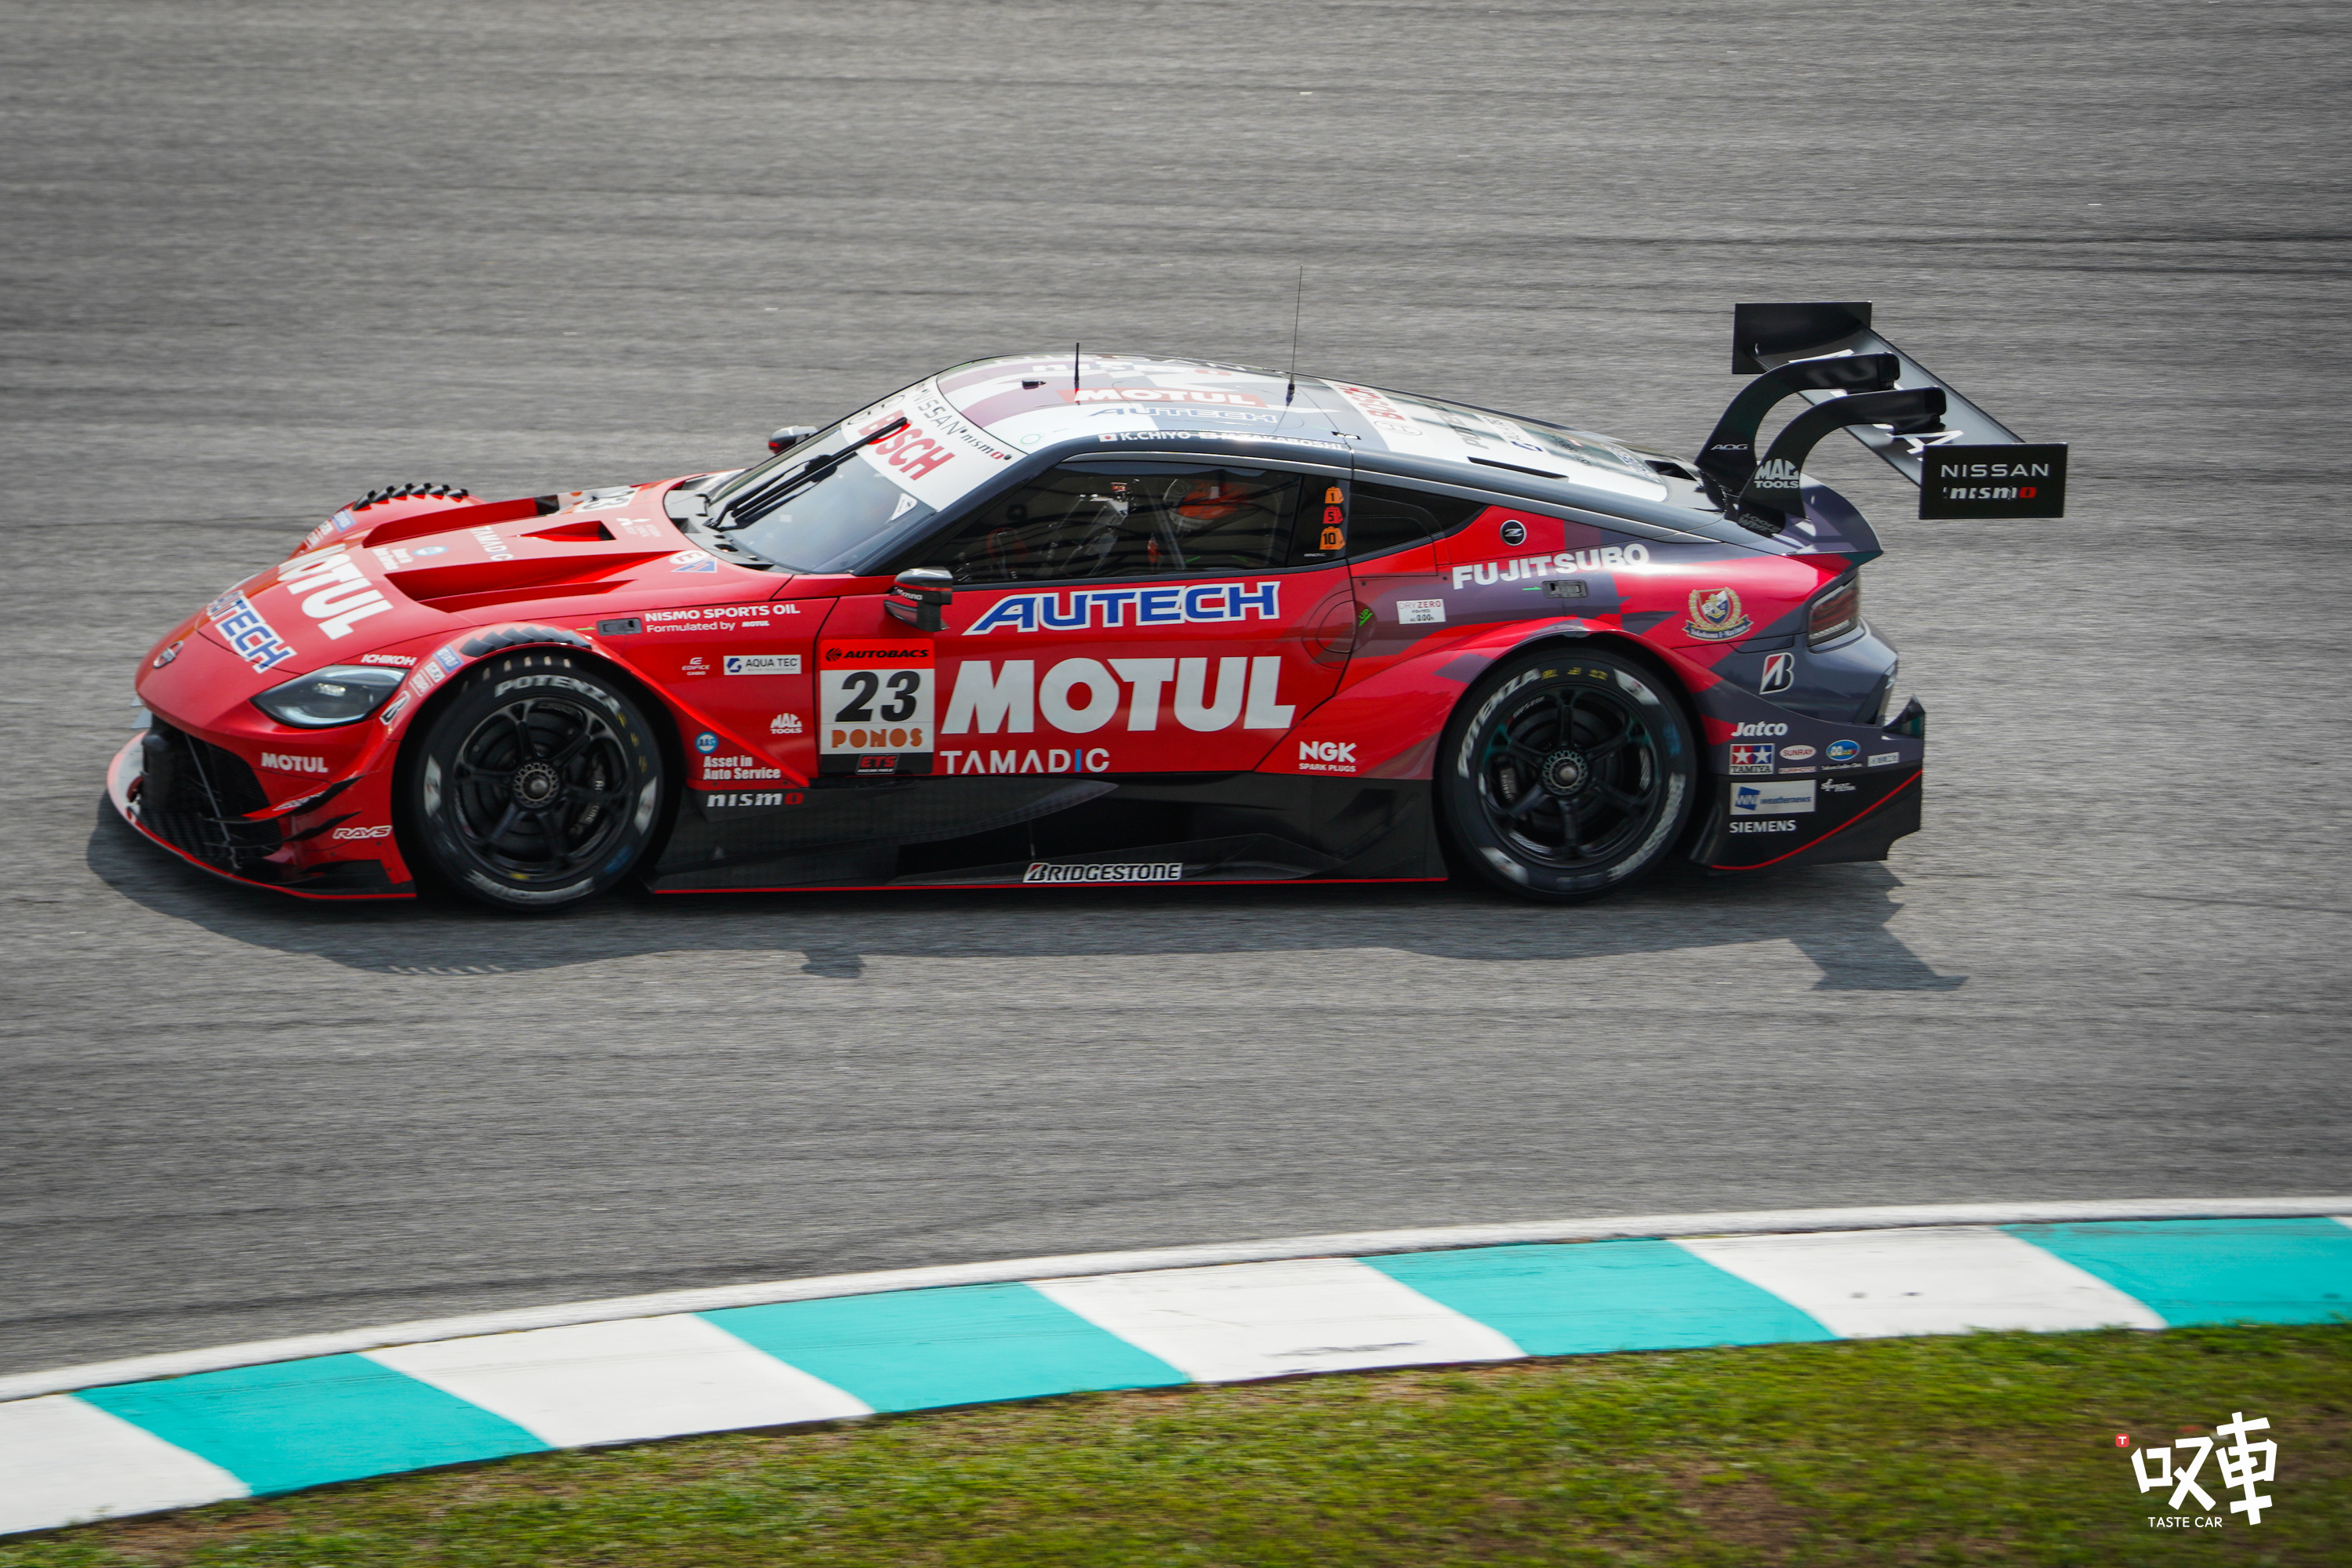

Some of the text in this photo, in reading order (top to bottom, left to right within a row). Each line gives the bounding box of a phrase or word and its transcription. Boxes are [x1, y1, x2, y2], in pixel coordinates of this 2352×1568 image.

[1074, 389, 1256, 407] MOTUL
[1334, 384, 1406, 421] BOSCH
[1087, 407, 1278, 423] AUTECH
[913, 389, 1004, 459] NISSAN nismo
[1120, 431, 1191, 441] K.CHIYO
[1941, 463, 2049, 477] NISSAN
[1949, 486, 2037, 499] nismo
[1328, 511, 1334, 521] 5
[1323, 532, 1336, 545] 10
[1452, 543, 1650, 590] FUJITSUBO
[645, 604, 800, 622] NISMO SPORTS OIL
[963, 581, 1281, 636] AUTECH
[646, 622, 717, 633] Formulated
[720, 621, 735, 631] by
[361, 654, 417, 666] ICHIKOH
[843, 649, 929, 659] AUTOBACS
[746, 658, 798, 667] AQUA TEC
[835, 670, 921, 722] 23
[941, 656, 1296, 735] MOTUL
[1731, 720, 1789, 737] Jatco
[831, 728, 924, 748] PONOS
[1299, 741, 1357, 764] NGK
[1782, 748, 1814, 757] SUNRAY
[260, 752, 328, 773] MOTUL
[703, 755, 753, 768] Asset in
[860, 755, 897, 768] ETS
[939, 747, 1110, 775] TAMADIC
[1299, 763, 1357, 772] SPARK PLUGS
[702, 767, 781, 780] Auto Service
[1731, 764, 1772, 774] TAMIYA
[707, 792, 804, 808] nismo
[1759, 795, 1812, 804] weathernews
[332, 825, 393, 840] RAYS
[1729, 820, 1797, 833] SIEMENS
[1023, 862, 1182, 883] BRIDGESTONE
